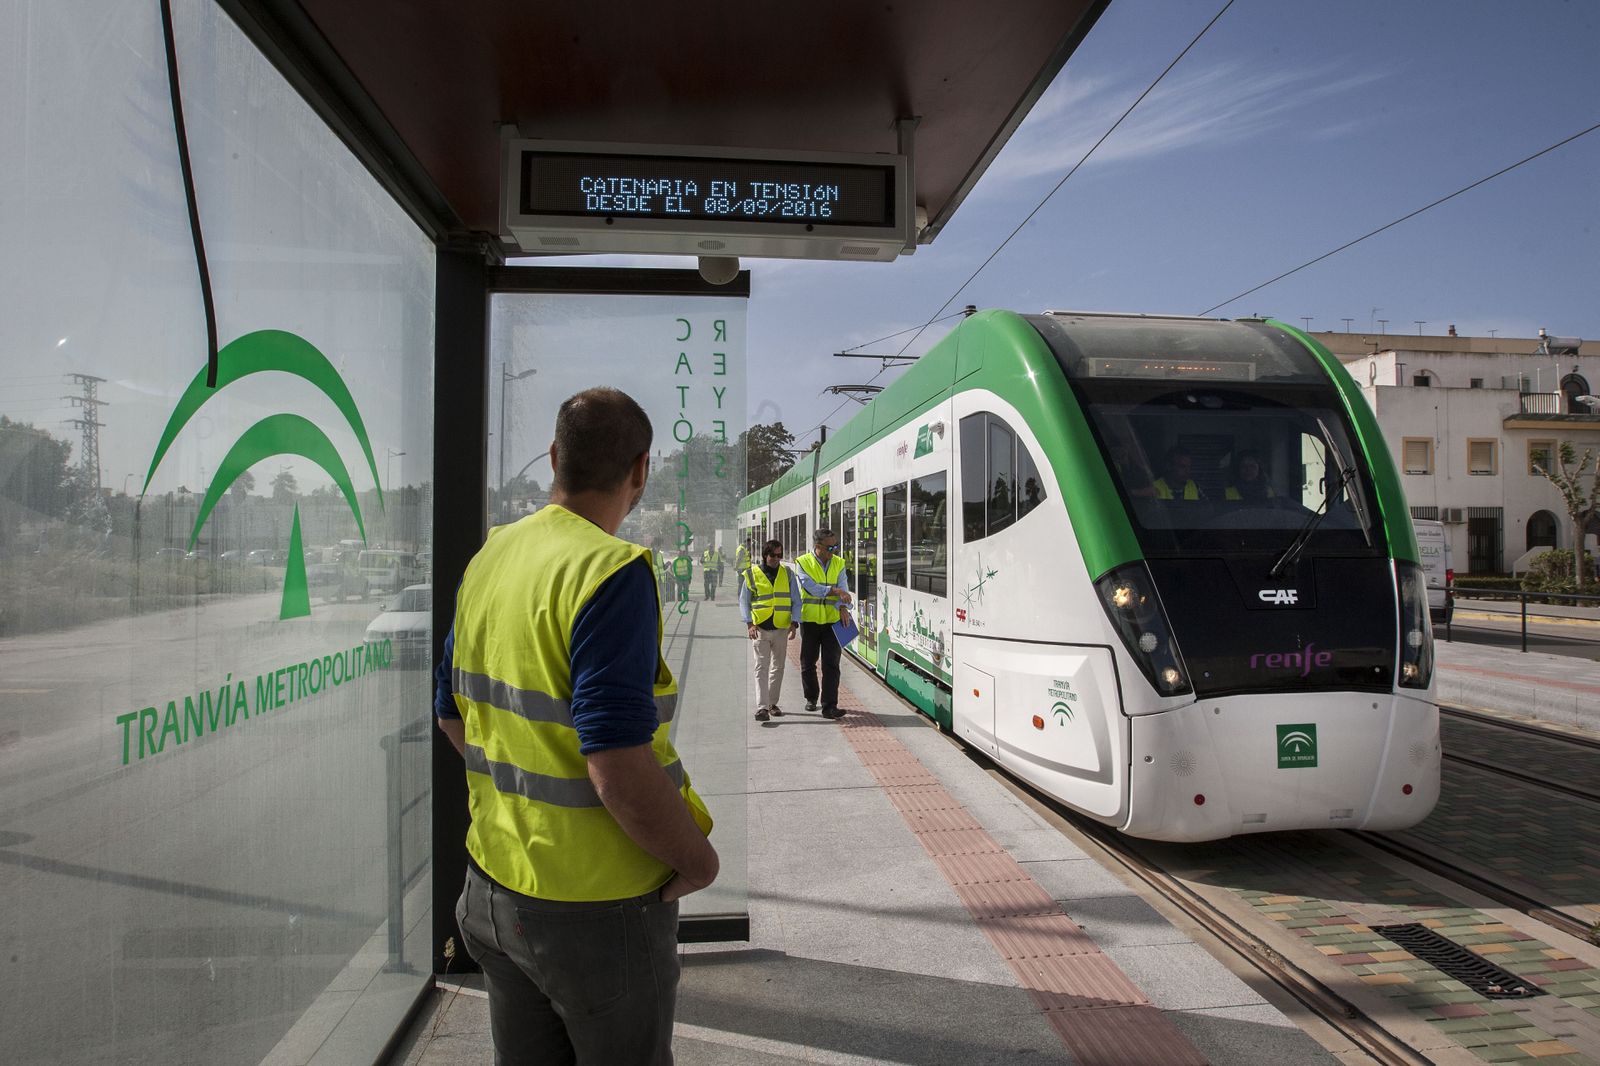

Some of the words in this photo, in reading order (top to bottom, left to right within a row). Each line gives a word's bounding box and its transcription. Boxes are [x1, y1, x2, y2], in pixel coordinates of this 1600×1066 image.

[579, 176, 698, 197] CATENARIA
[710, 181, 737, 197] EN
[586, 194, 652, 212] DESDE
[665, 196, 691, 213] EL
[704, 200, 832, 217] 08/09/2016
[1258, 589, 1299, 605] CAF
[1250, 643, 1332, 677] renfe
[116, 672, 250, 765] TRANVÍA
[255, 638, 393, 716] METROPOLITANO
